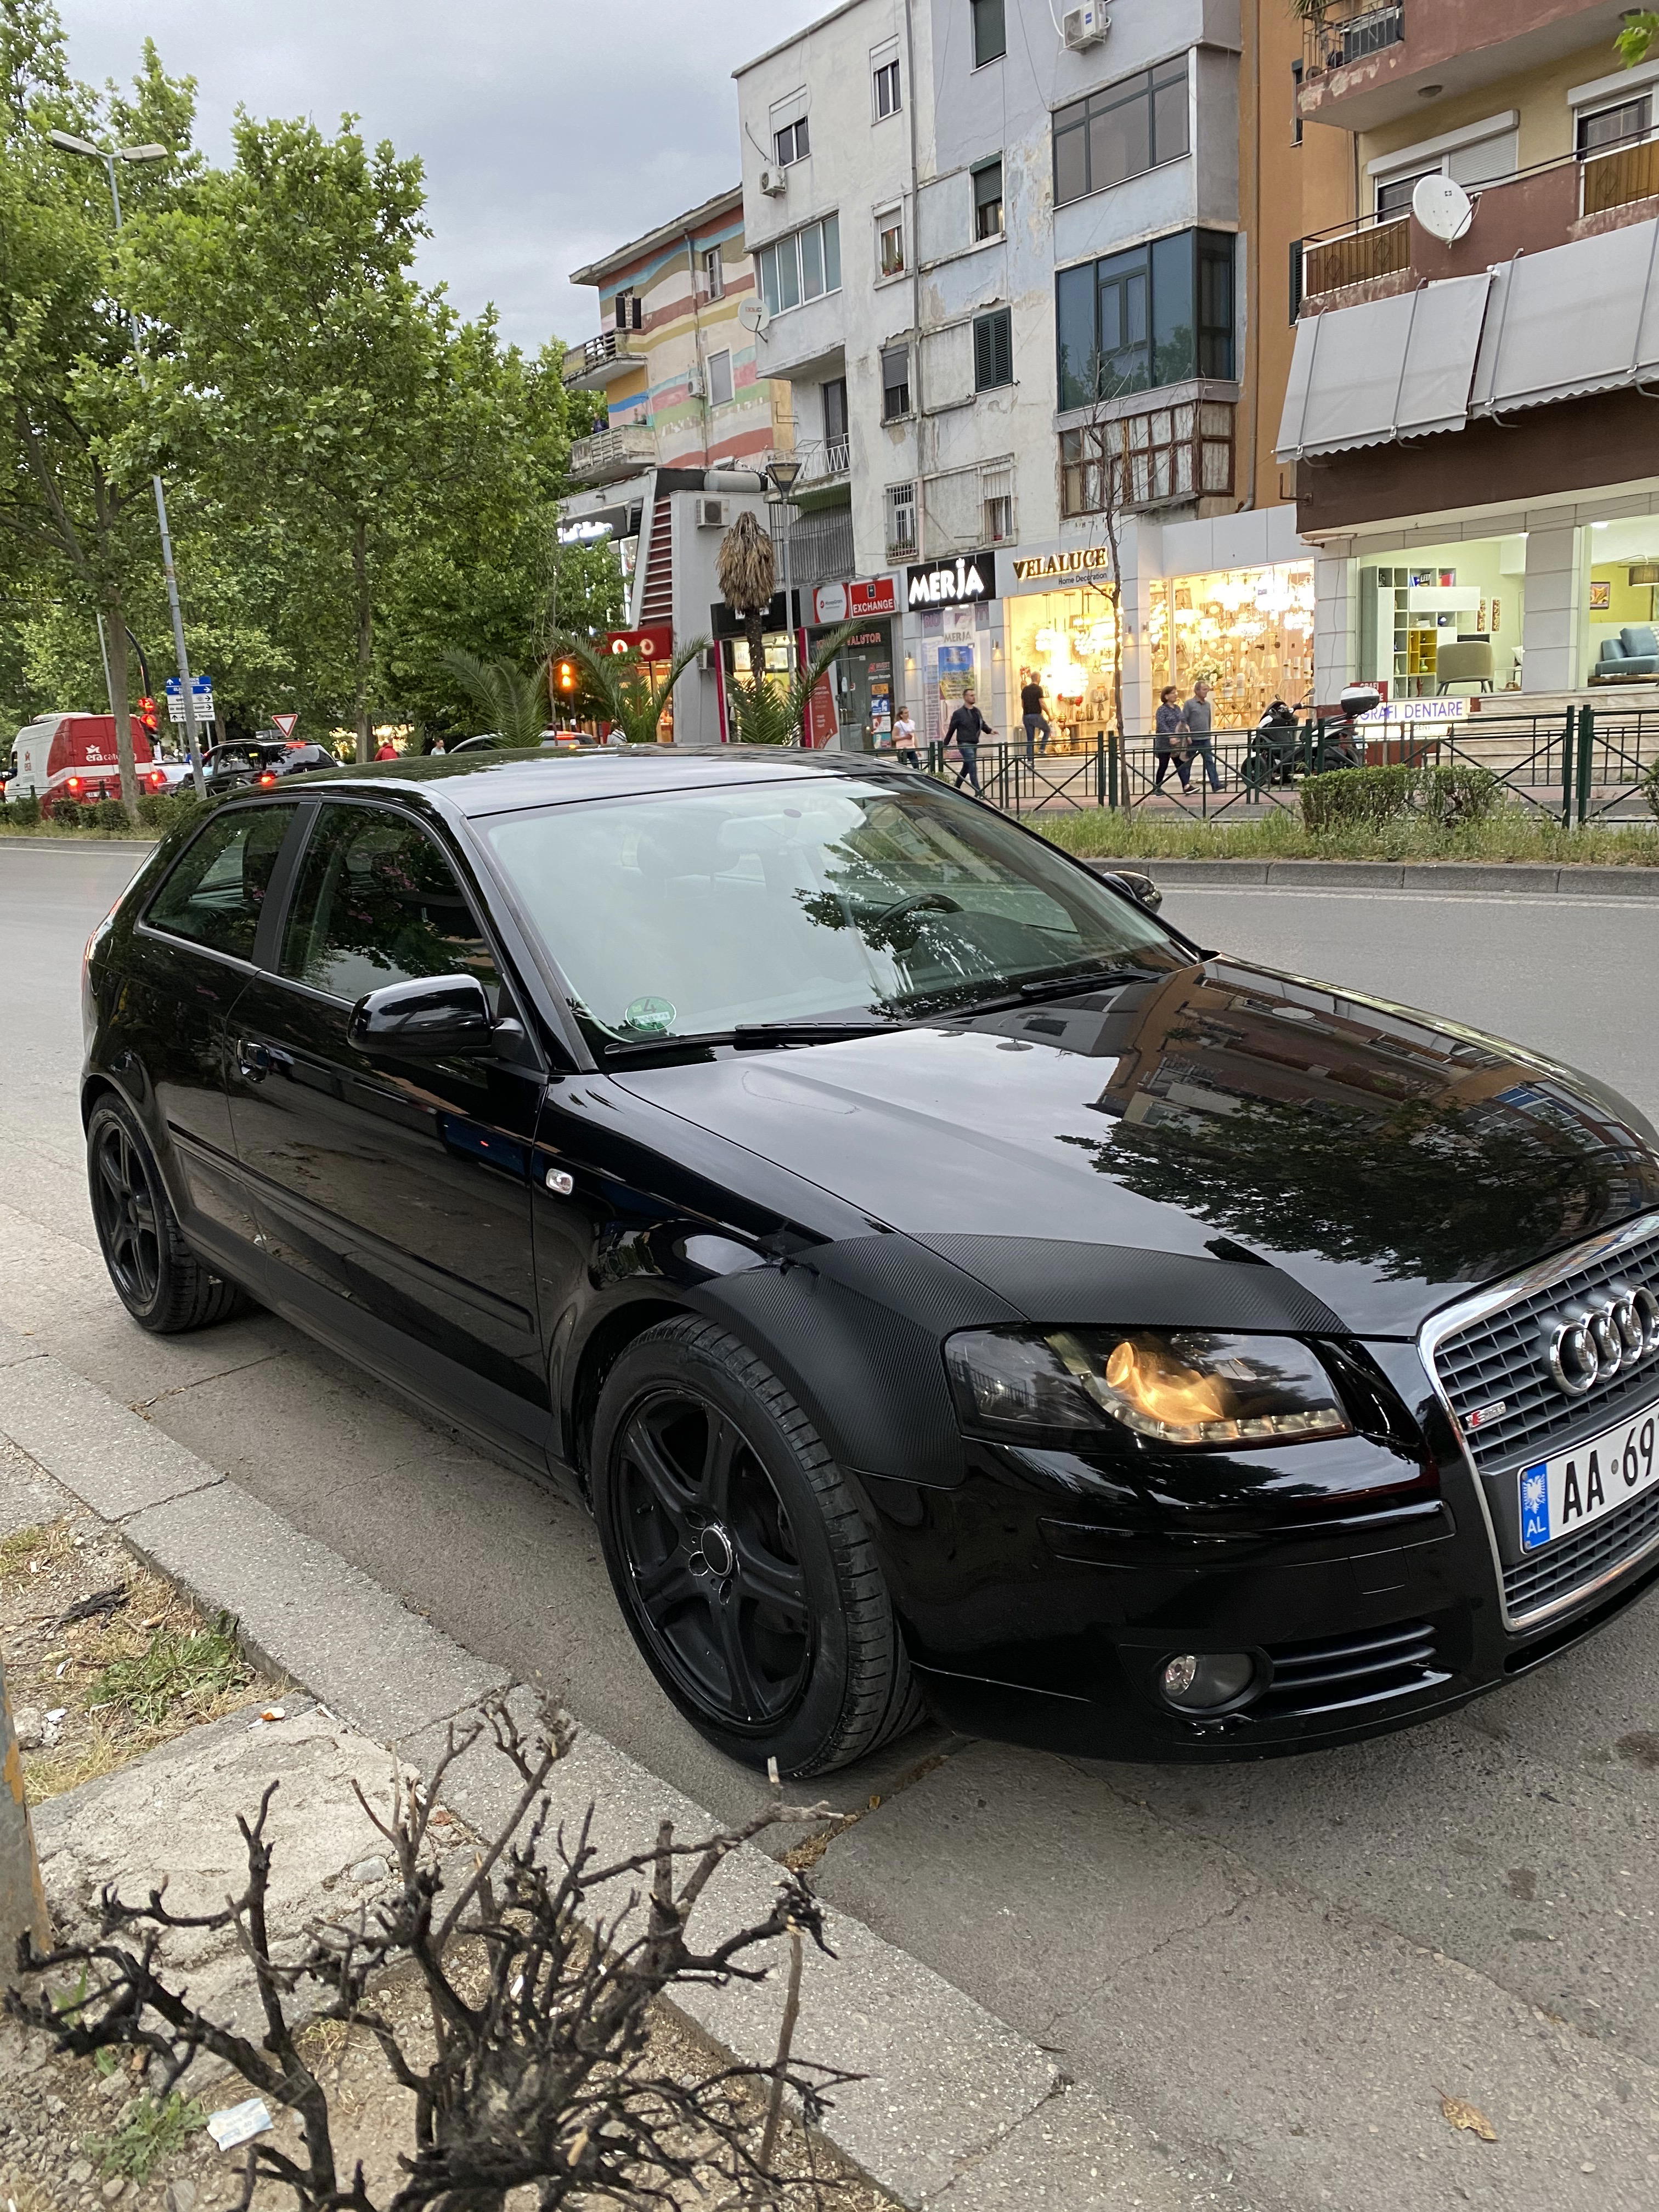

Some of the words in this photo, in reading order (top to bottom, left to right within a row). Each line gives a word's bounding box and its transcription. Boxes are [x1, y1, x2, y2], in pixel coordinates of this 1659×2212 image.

[1013, 547, 1108, 580] VELALUCE
[909, 557, 985, 605] MERJA
[1058, 577, 1074, 585] Home
[1076, 572, 1107, 583] Decoration
[853, 598, 894, 613] EXCHANGE
[944, 630, 972, 643] MERJA
[1404, 701, 1463, 719] DENTARE
[86, 753, 103, 762] era
[643, 998, 657, 1014] 4
[1562, 1449, 1605, 1525] AA
[1622, 1412, 1659, 1487] 69
[1526, 1516, 1547, 1538] AL
